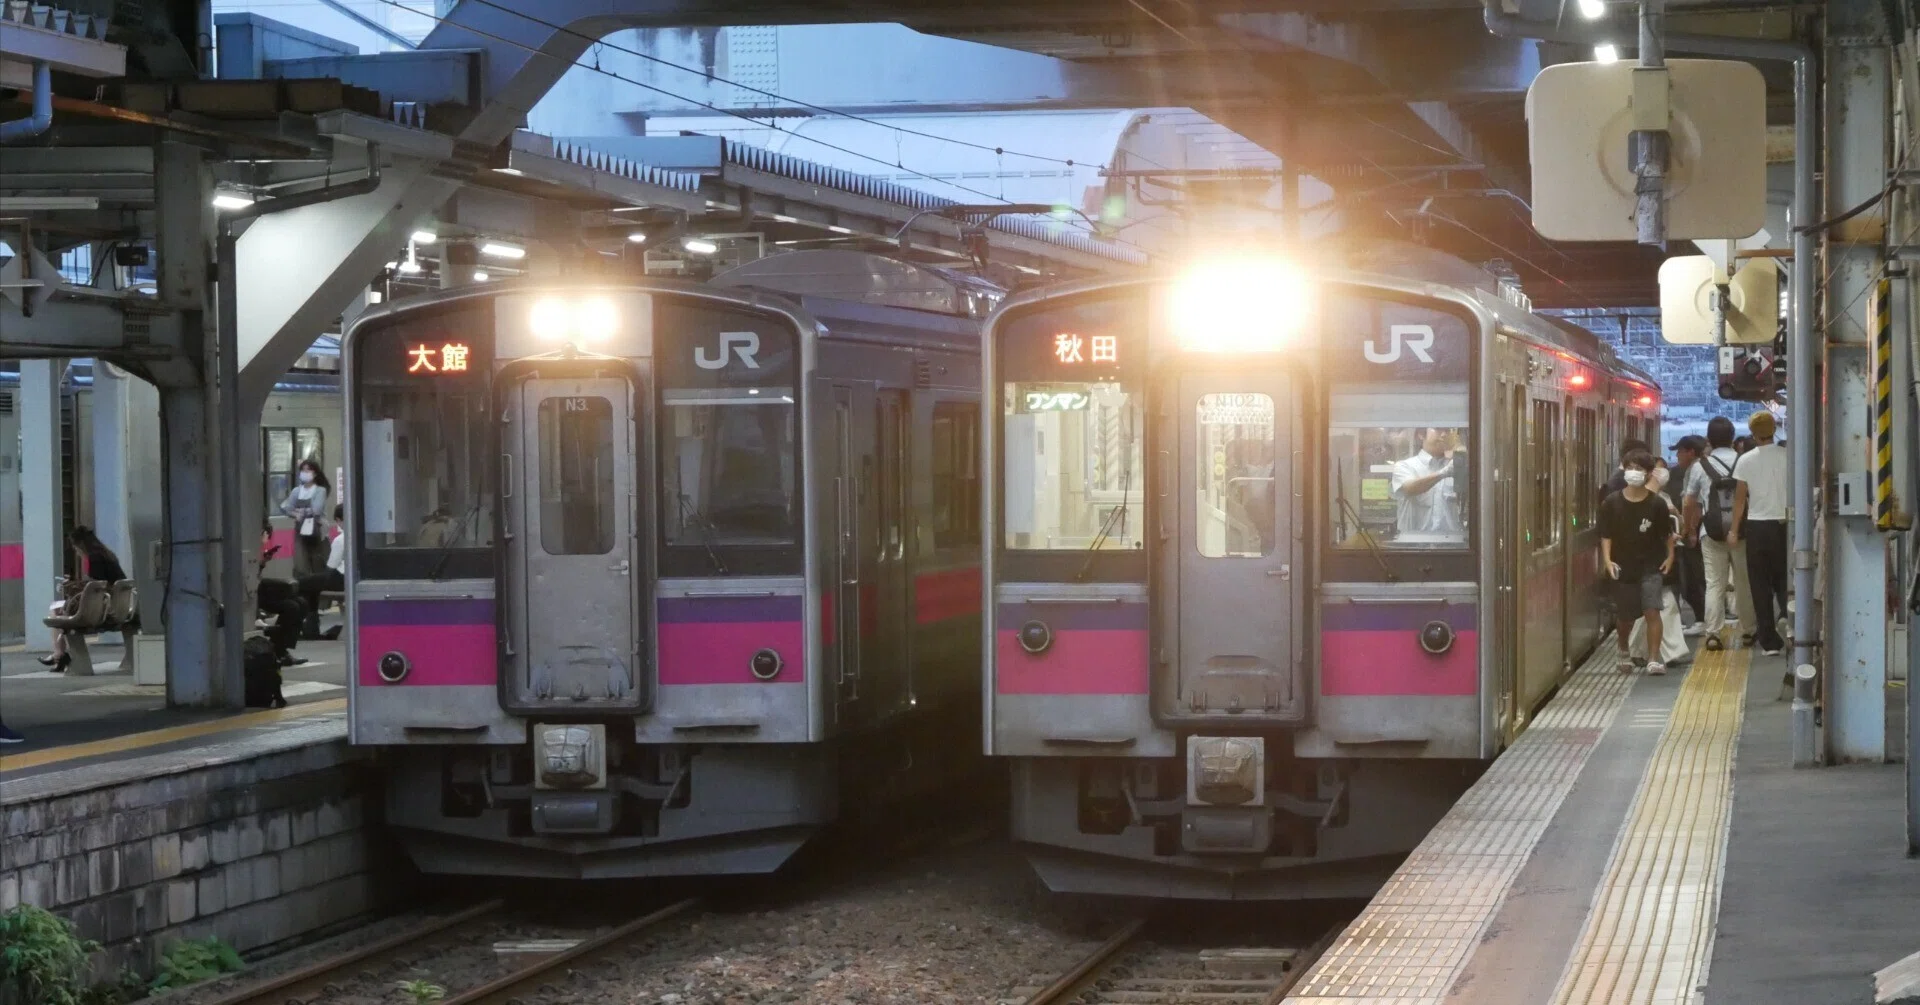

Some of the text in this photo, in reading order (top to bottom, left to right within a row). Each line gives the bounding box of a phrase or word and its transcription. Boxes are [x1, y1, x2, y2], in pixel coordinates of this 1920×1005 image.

[408, 343, 469, 372] 大館
[694, 331, 760, 370] JR
[1054, 333, 1117, 363] 秋田
[1363, 324, 1435, 364] JR
[1026, 392, 1089, 410] ワンマン
